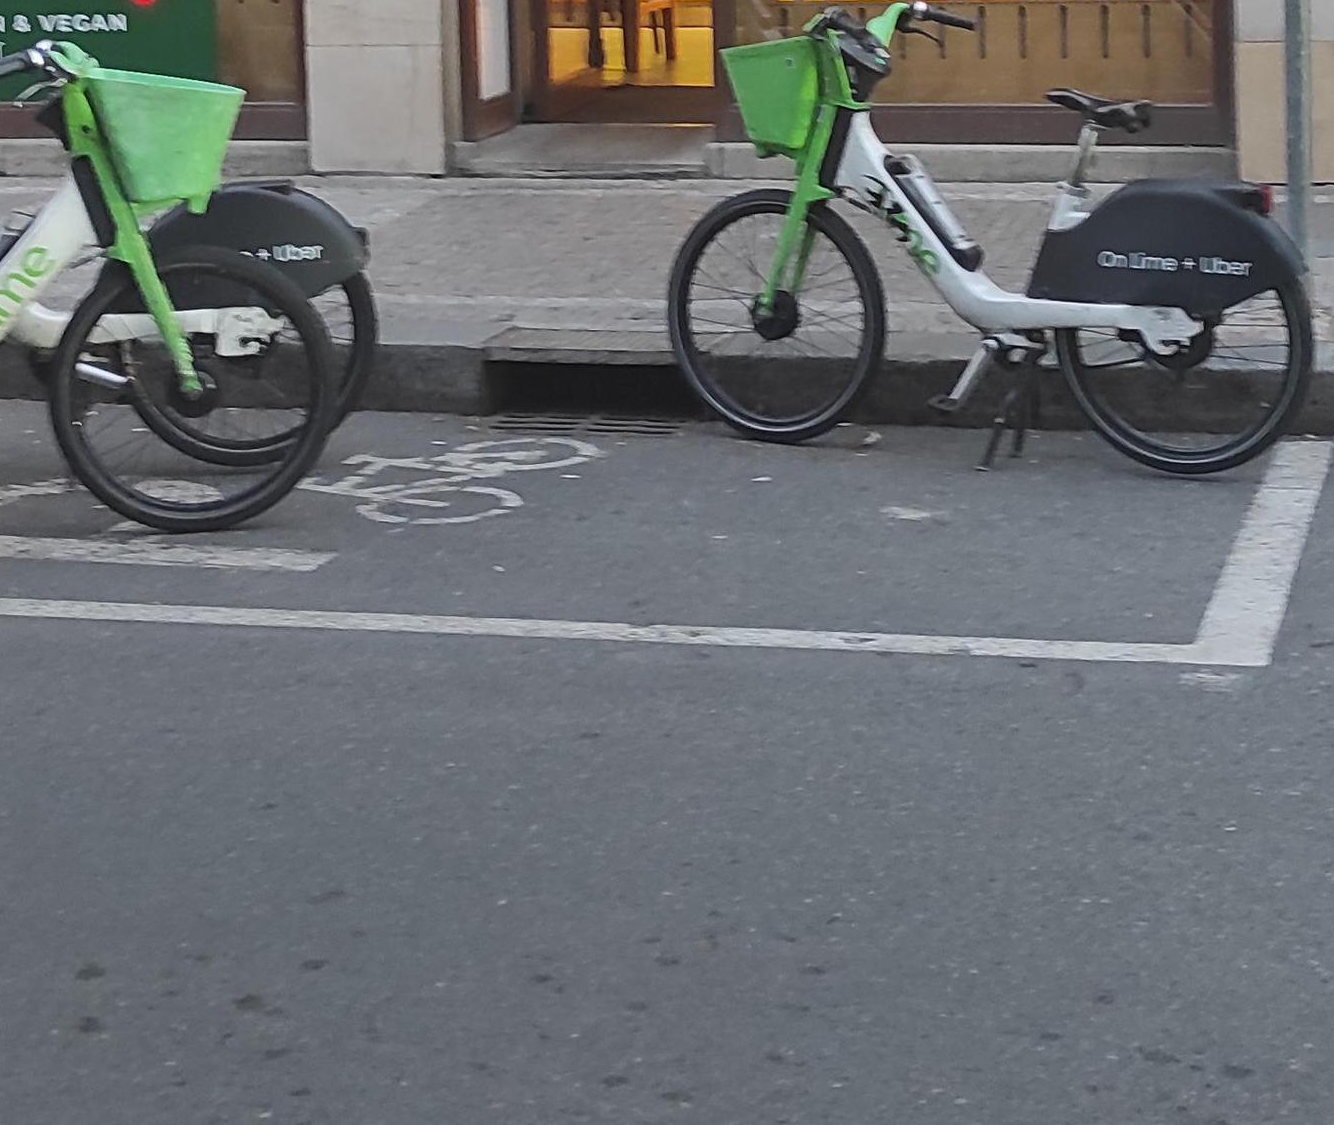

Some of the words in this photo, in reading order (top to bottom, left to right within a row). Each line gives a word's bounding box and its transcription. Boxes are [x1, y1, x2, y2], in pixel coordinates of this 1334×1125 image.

[11, 13, 32, 33] &
[37, 12, 128, 32] VEGAN
[1097, 250, 1128, 268] On
[1199, 256, 1253, 277] Uber
